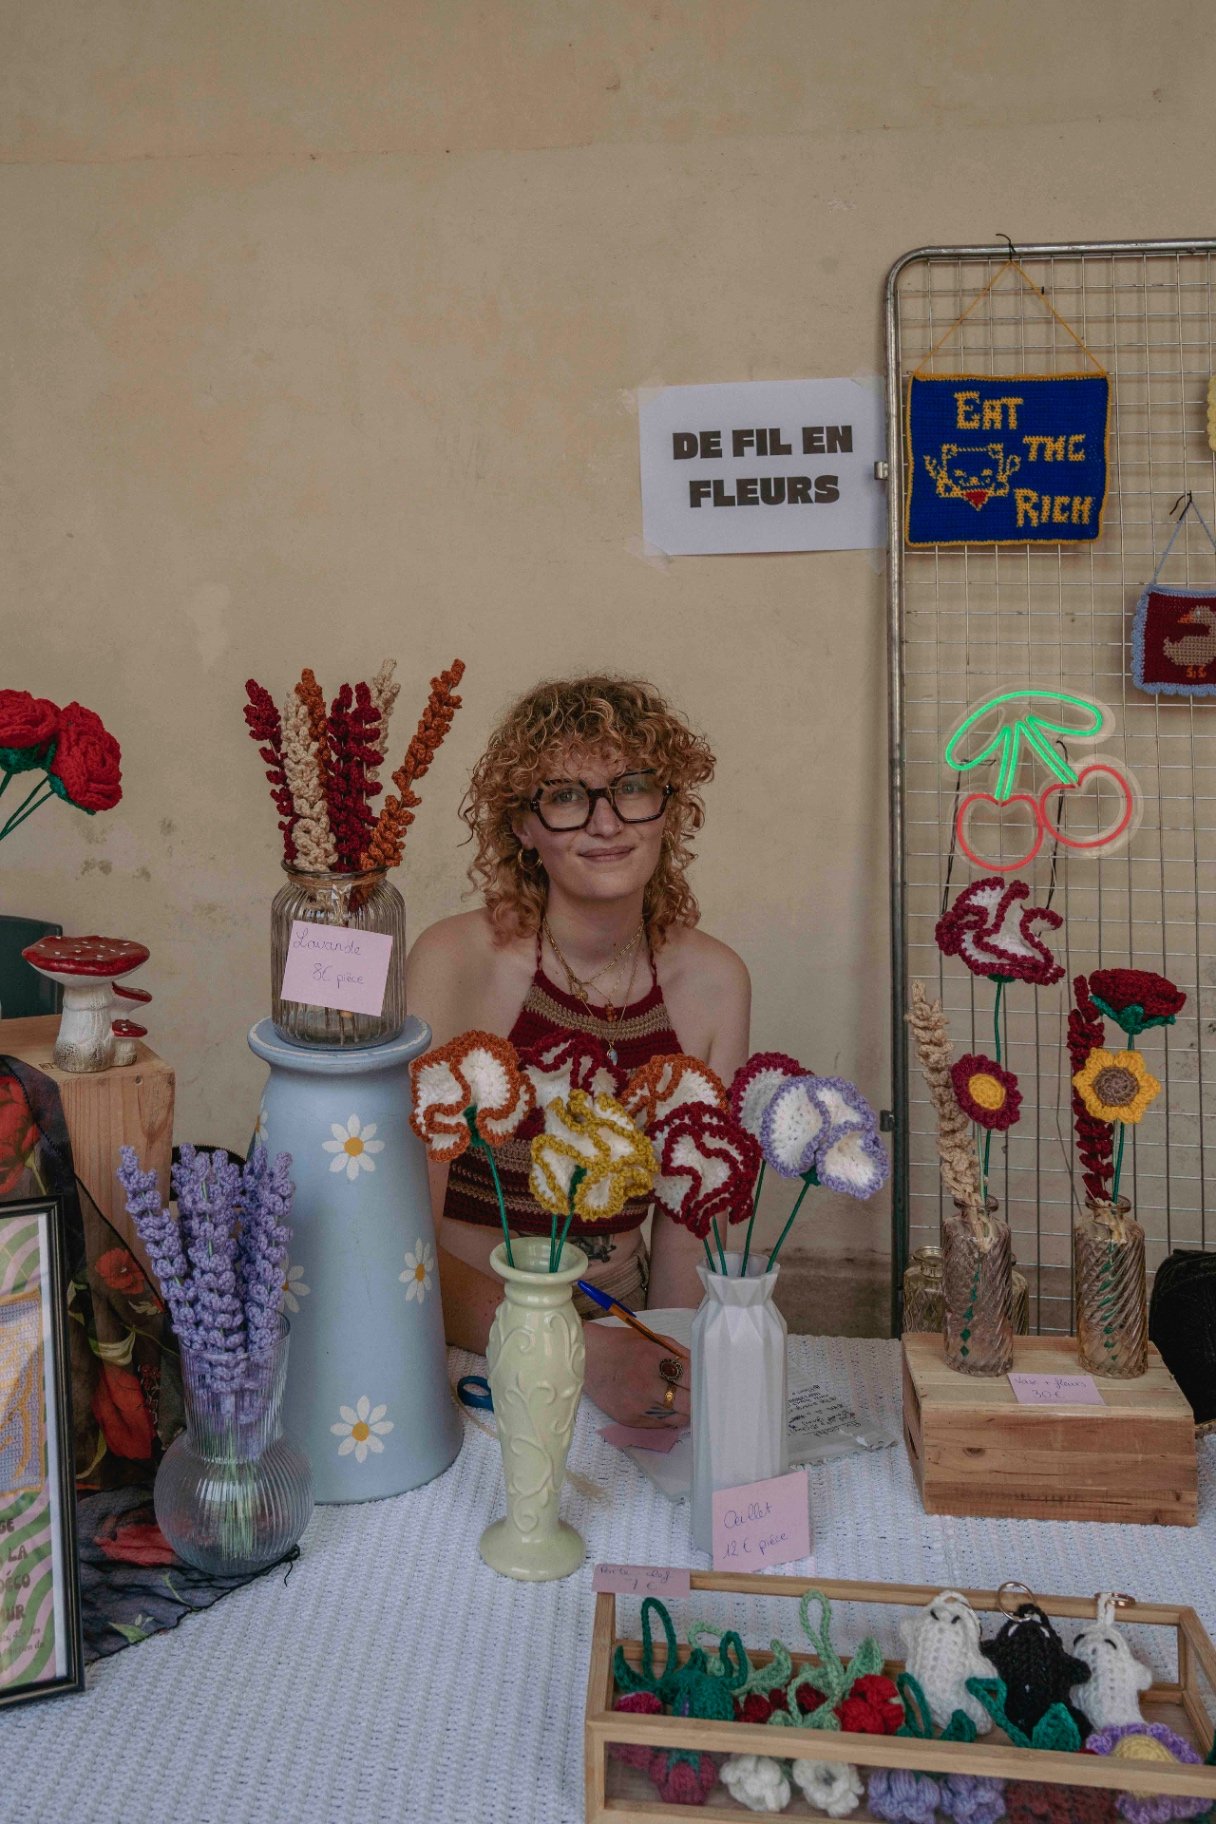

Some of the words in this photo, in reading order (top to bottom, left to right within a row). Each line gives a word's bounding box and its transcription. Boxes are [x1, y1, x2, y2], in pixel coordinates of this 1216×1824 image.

[954, 391, 1024, 430] EAT
[672, 430, 723, 460] DE
[732, 428, 792, 457] FIL
[802, 425, 853, 454] EN
[689, 475, 840, 508] FLEURS
[1014, 488, 1093, 527] RICH
[293, 927, 361, 956] Lavande
